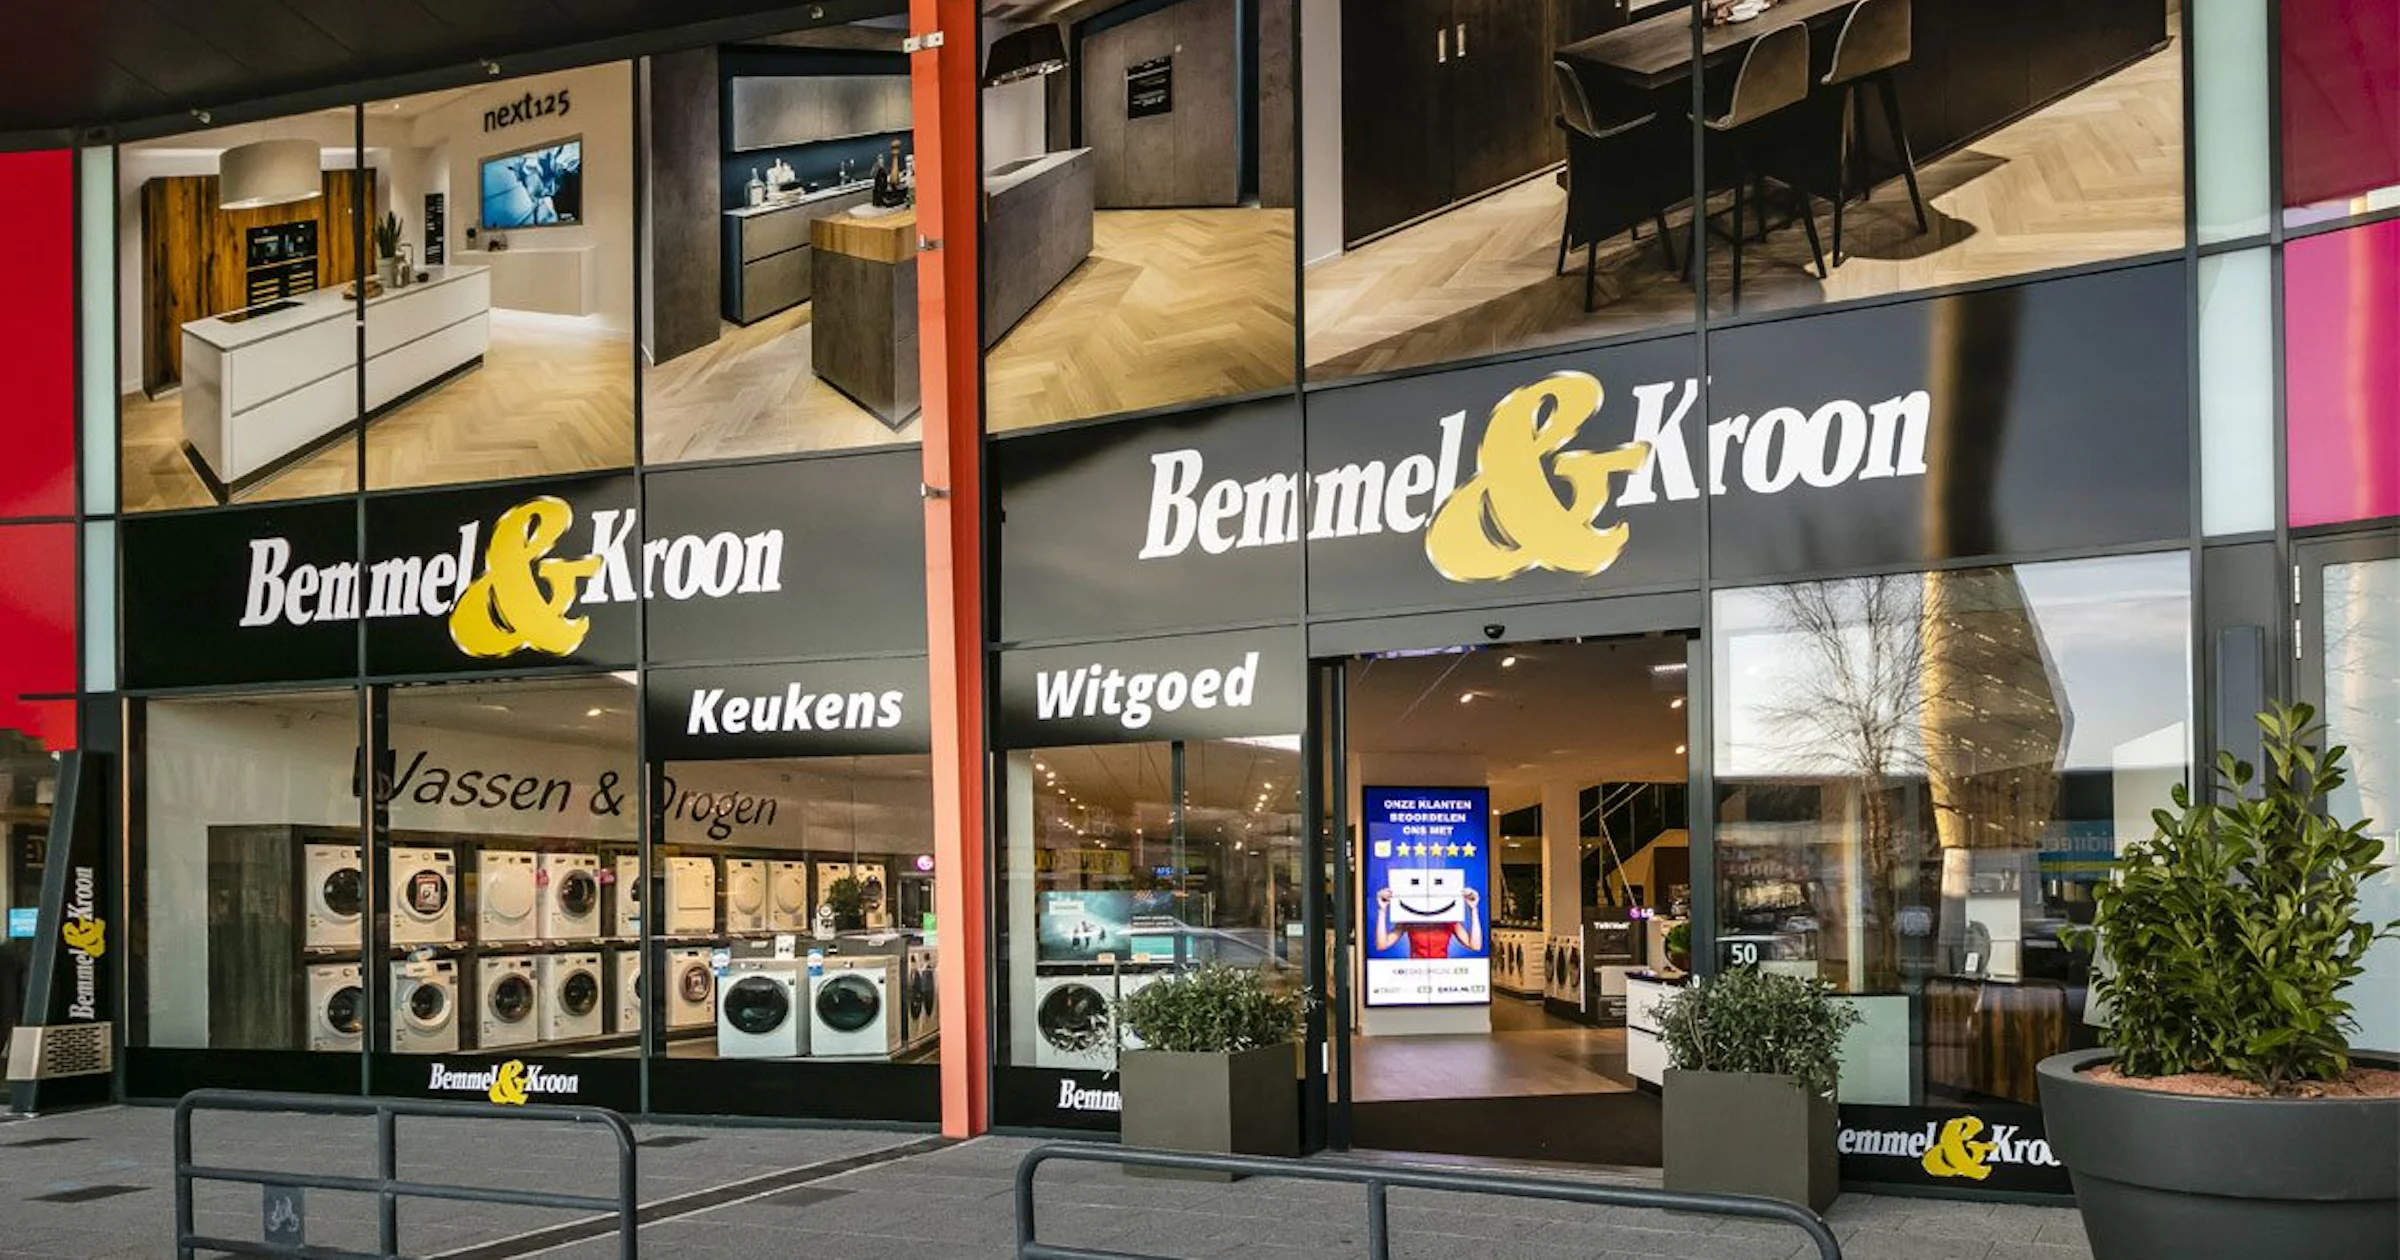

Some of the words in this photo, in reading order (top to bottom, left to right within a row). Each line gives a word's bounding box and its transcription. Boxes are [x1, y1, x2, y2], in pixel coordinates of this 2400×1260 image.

[483, 90, 570, 133] next125
[1036, 651, 1260, 729] Witgoed
[687, 682, 904, 735] Keukens
[589, 771, 626, 816] &
[1383, 799, 1416, 810] ONZE
[1418, 799, 1472, 810] KLANTEN
[1389, 813, 1467, 823] BEOORDELEN
[1402, 825, 1427, 836] ONS
[1429, 826, 1455, 836] MET
[1731, 943, 1758, 965] 50
[1056, 1079, 1123, 1111] Bemm
